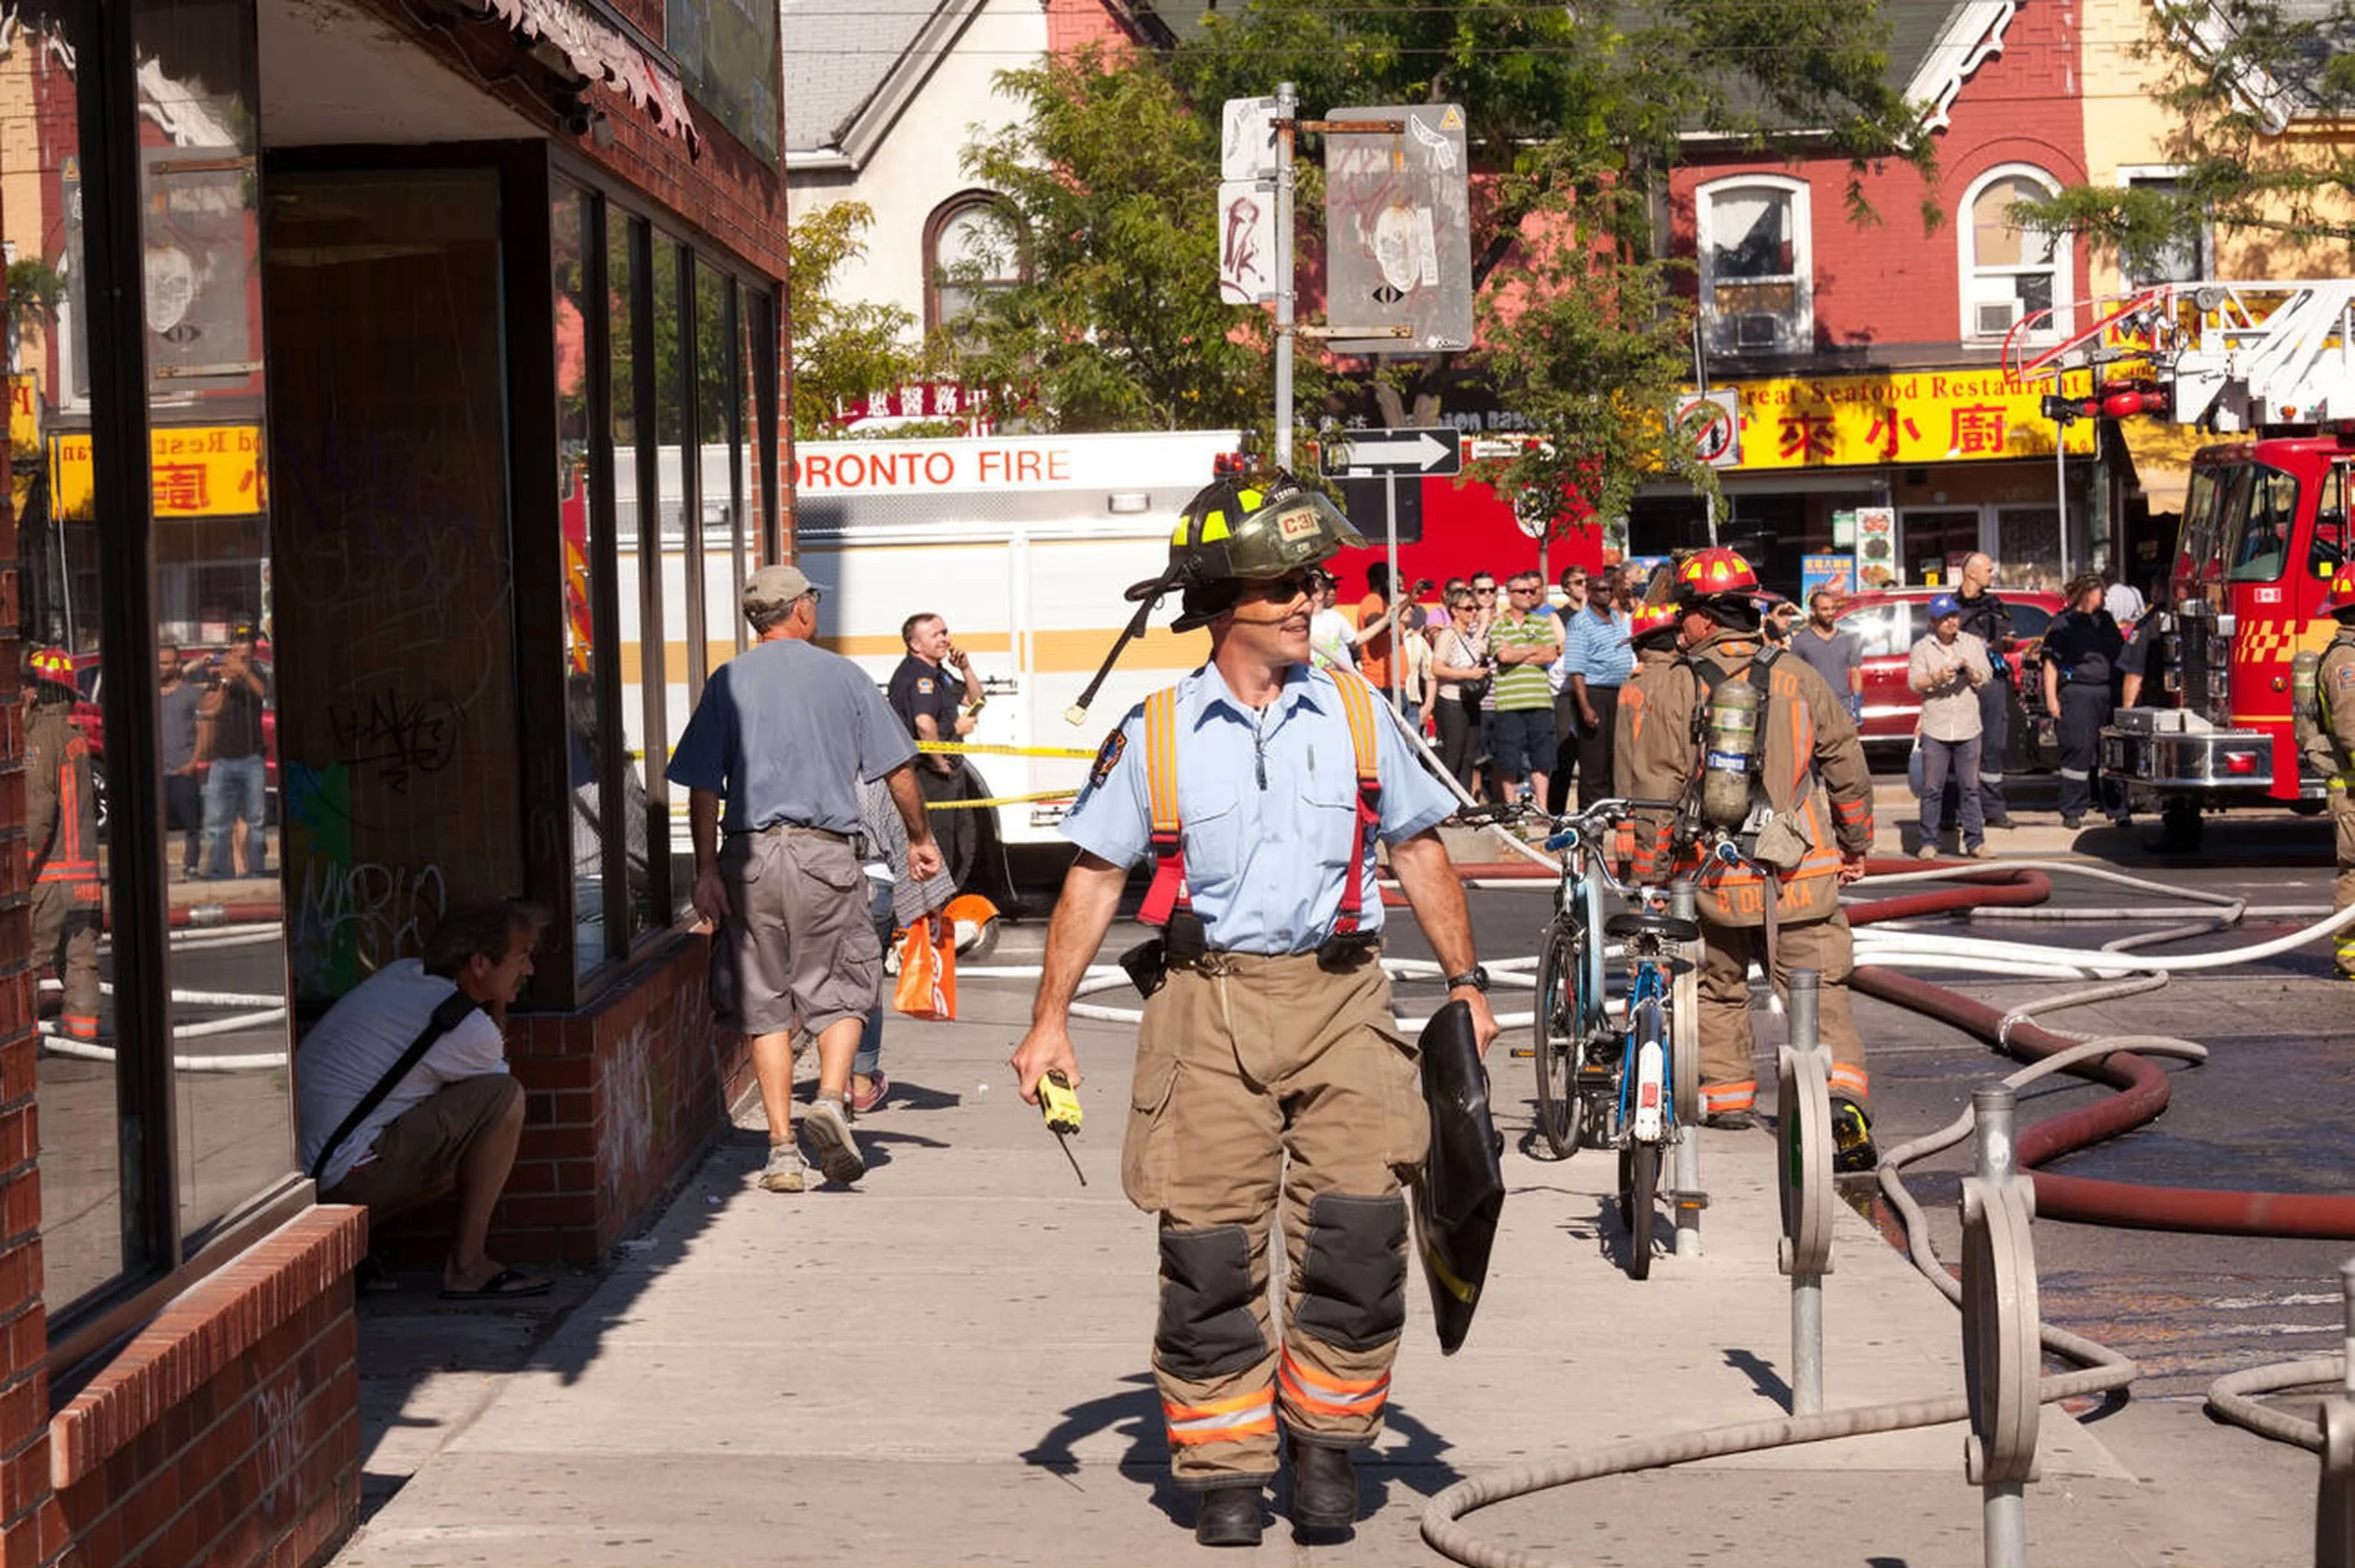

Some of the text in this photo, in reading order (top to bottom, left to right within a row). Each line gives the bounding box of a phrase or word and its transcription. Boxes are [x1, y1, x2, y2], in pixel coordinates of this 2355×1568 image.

[1731, 374, 2080, 406] reat Seafood Restaurant
[1739, 403, 2007, 464] 來小廚
[795, 450, 1072, 488] RONTO FIRE
[1740, 882, 1813, 913] DUKA
